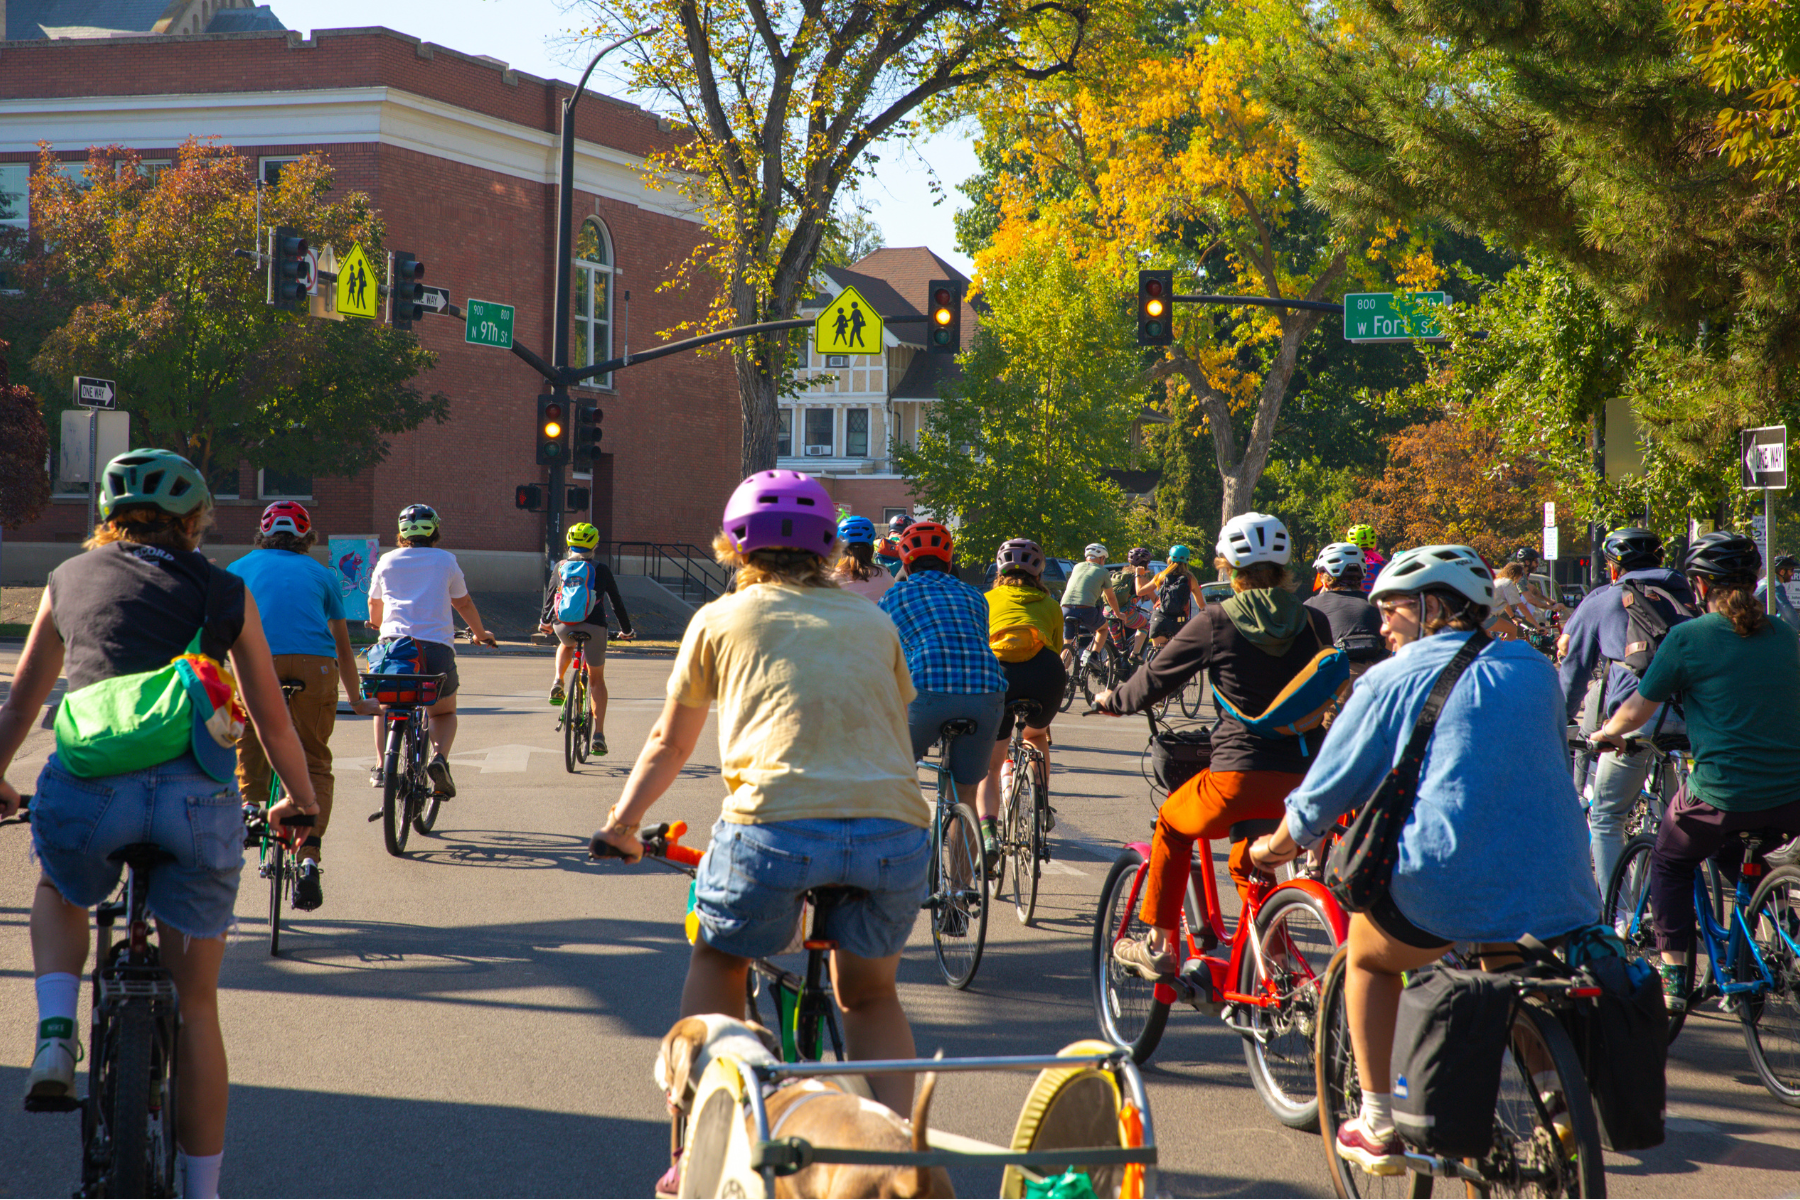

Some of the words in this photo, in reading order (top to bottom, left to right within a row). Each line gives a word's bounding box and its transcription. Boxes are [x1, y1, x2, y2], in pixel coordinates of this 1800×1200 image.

[426, 294, 438, 305] WAY
[1357, 298, 1376, 310] 800
[473, 304, 484, 316] 900
[500, 309, 510, 320] 800
[471, 326, 477, 339] N
[480, 321, 498, 342] 9Th
[500, 330, 508, 343] St
[1373, 315, 1410, 335] Fort
[82, 385, 93, 398] ONE
[94, 387, 105, 399] WAY
[1756, 447, 1768, 469] ONE
[1770, 446, 1783, 469] WAY
[133, 547, 175, 561] ECORD
